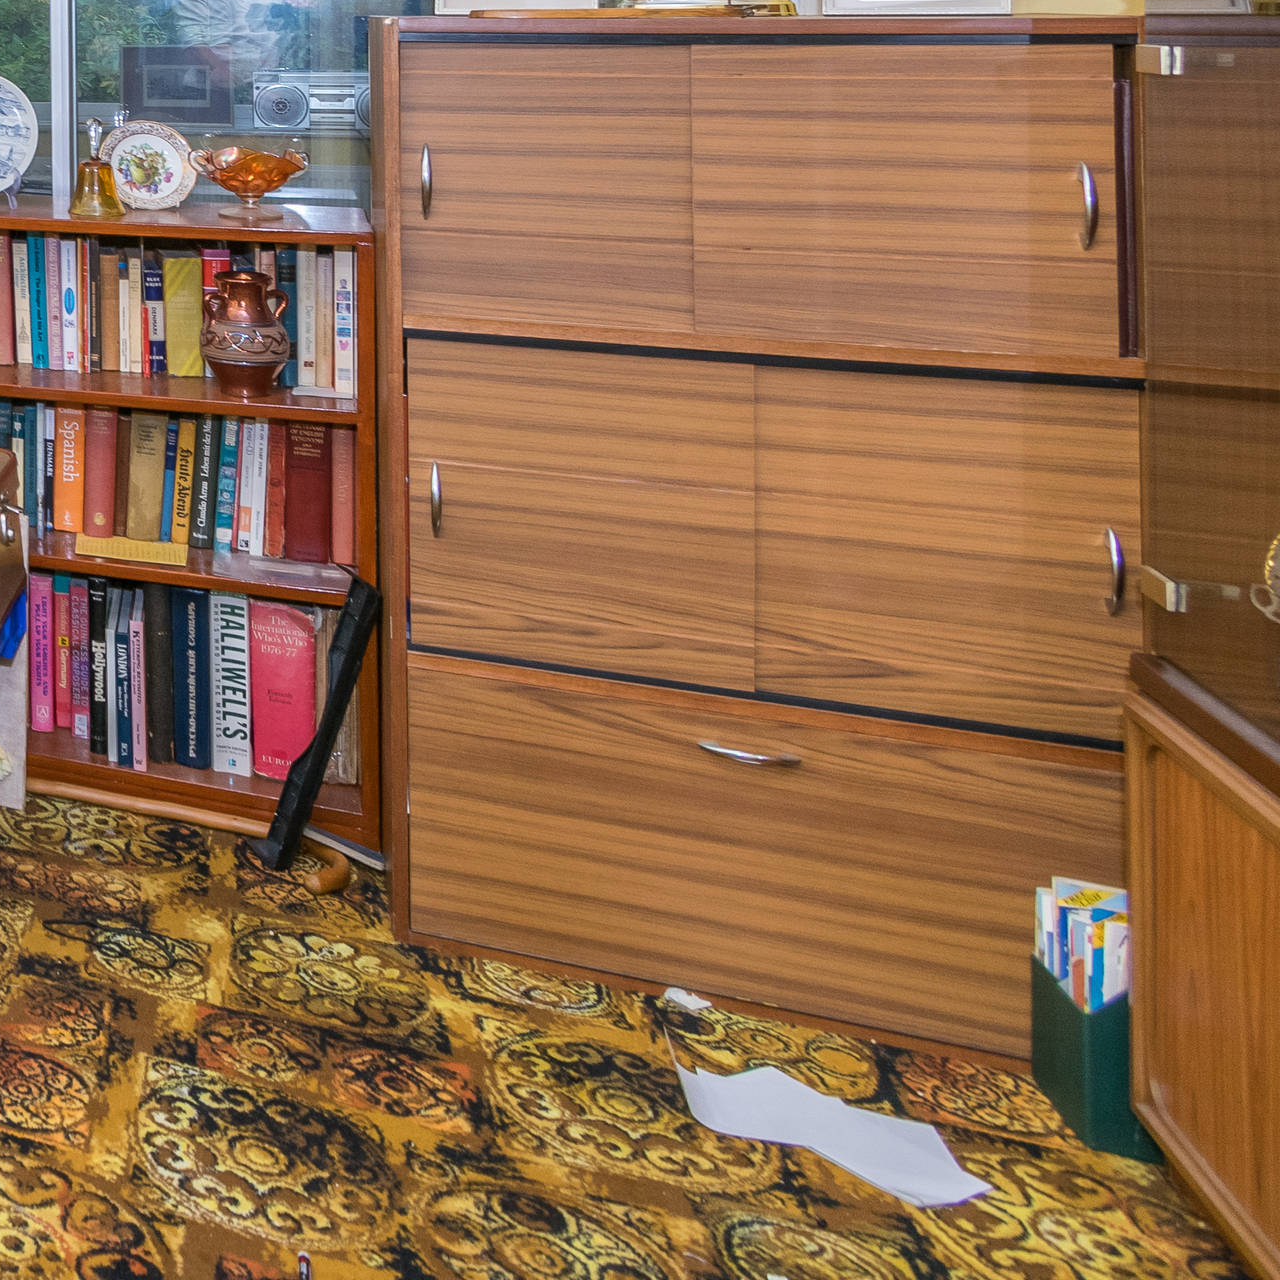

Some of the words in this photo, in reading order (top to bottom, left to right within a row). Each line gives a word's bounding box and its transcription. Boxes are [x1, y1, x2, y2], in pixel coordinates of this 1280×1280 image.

[58, 421, 80, 482] Spanish
[178, 447, 192, 482] Heute
[200, 457, 209, 477] Leben
[176, 482, 190, 518] Abend
[197, 501, 208, 527] Claudio
[72, 595, 80, 646] CLASSICAL
[80, 597, 88, 610] THE
[270, 616, 288, 626] The
[80, 611, 88, 662] GUINNESS
[251, 620, 309, 638] International
[252, 630, 280, 642] Who's
[282, 635, 308, 647] Who
[58, 648, 69, 689] Germany
[72, 649, 81, 705] COMPOSERS
[80, 664, 89, 693] GUIDE
[92, 640, 106, 702] Hollywood
[117, 643, 128, 679] LONDON
[220, 603, 248, 740] HALLIWELL'S
[81, 695, 89, 707] TO
